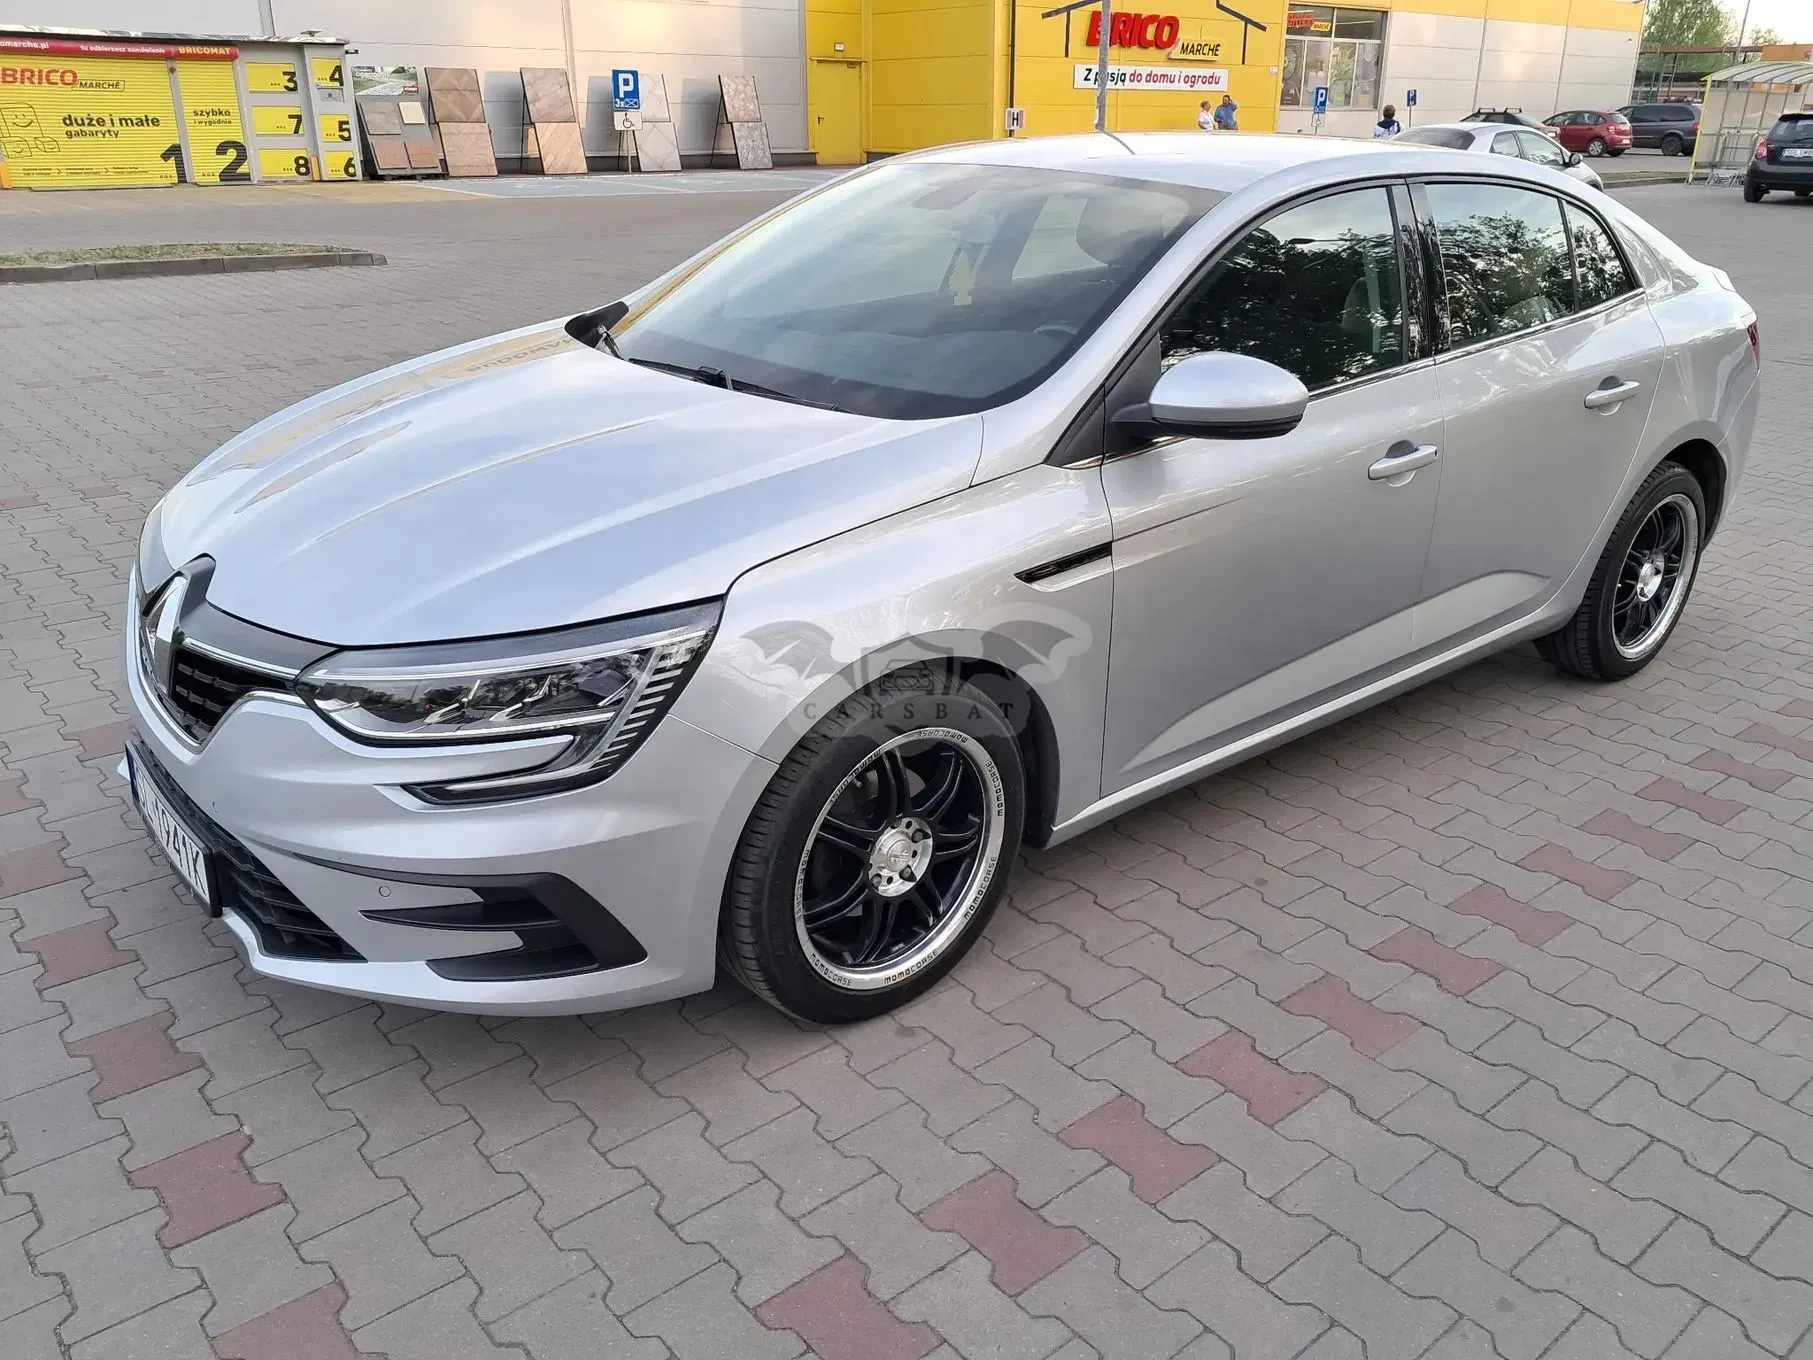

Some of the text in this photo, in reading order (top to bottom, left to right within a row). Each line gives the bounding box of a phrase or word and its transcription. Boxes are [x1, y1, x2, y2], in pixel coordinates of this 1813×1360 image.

[178, 47, 231, 55] BRICOMAT
[1, 66, 78, 86] BRICO
[282, 71, 298, 92] 3
[329, 65, 344, 87] 4
[618, 73, 634, 98] P
[1083, 68, 1093, 82] Z
[1129, 69, 1144, 83] do
[1145, 69, 1177, 83] domu
[1184, 71, 1221, 88] ogrodu
[1317, 89, 1326, 106] P
[62, 113, 160, 127] duże i małe
[193, 108, 231, 118] szybko
[198, 119, 232, 127] wygodnie
[1011, 111, 1019, 127] H
[65, 129, 120, 139] gabaryty
[288, 114, 303, 135] 7
[338, 120, 352, 141] 5
[160, 143, 188, 184] 1
[216, 140, 252, 182] 2
[294, 156, 311, 177] 8
[344, 157, 357, 177] 6
